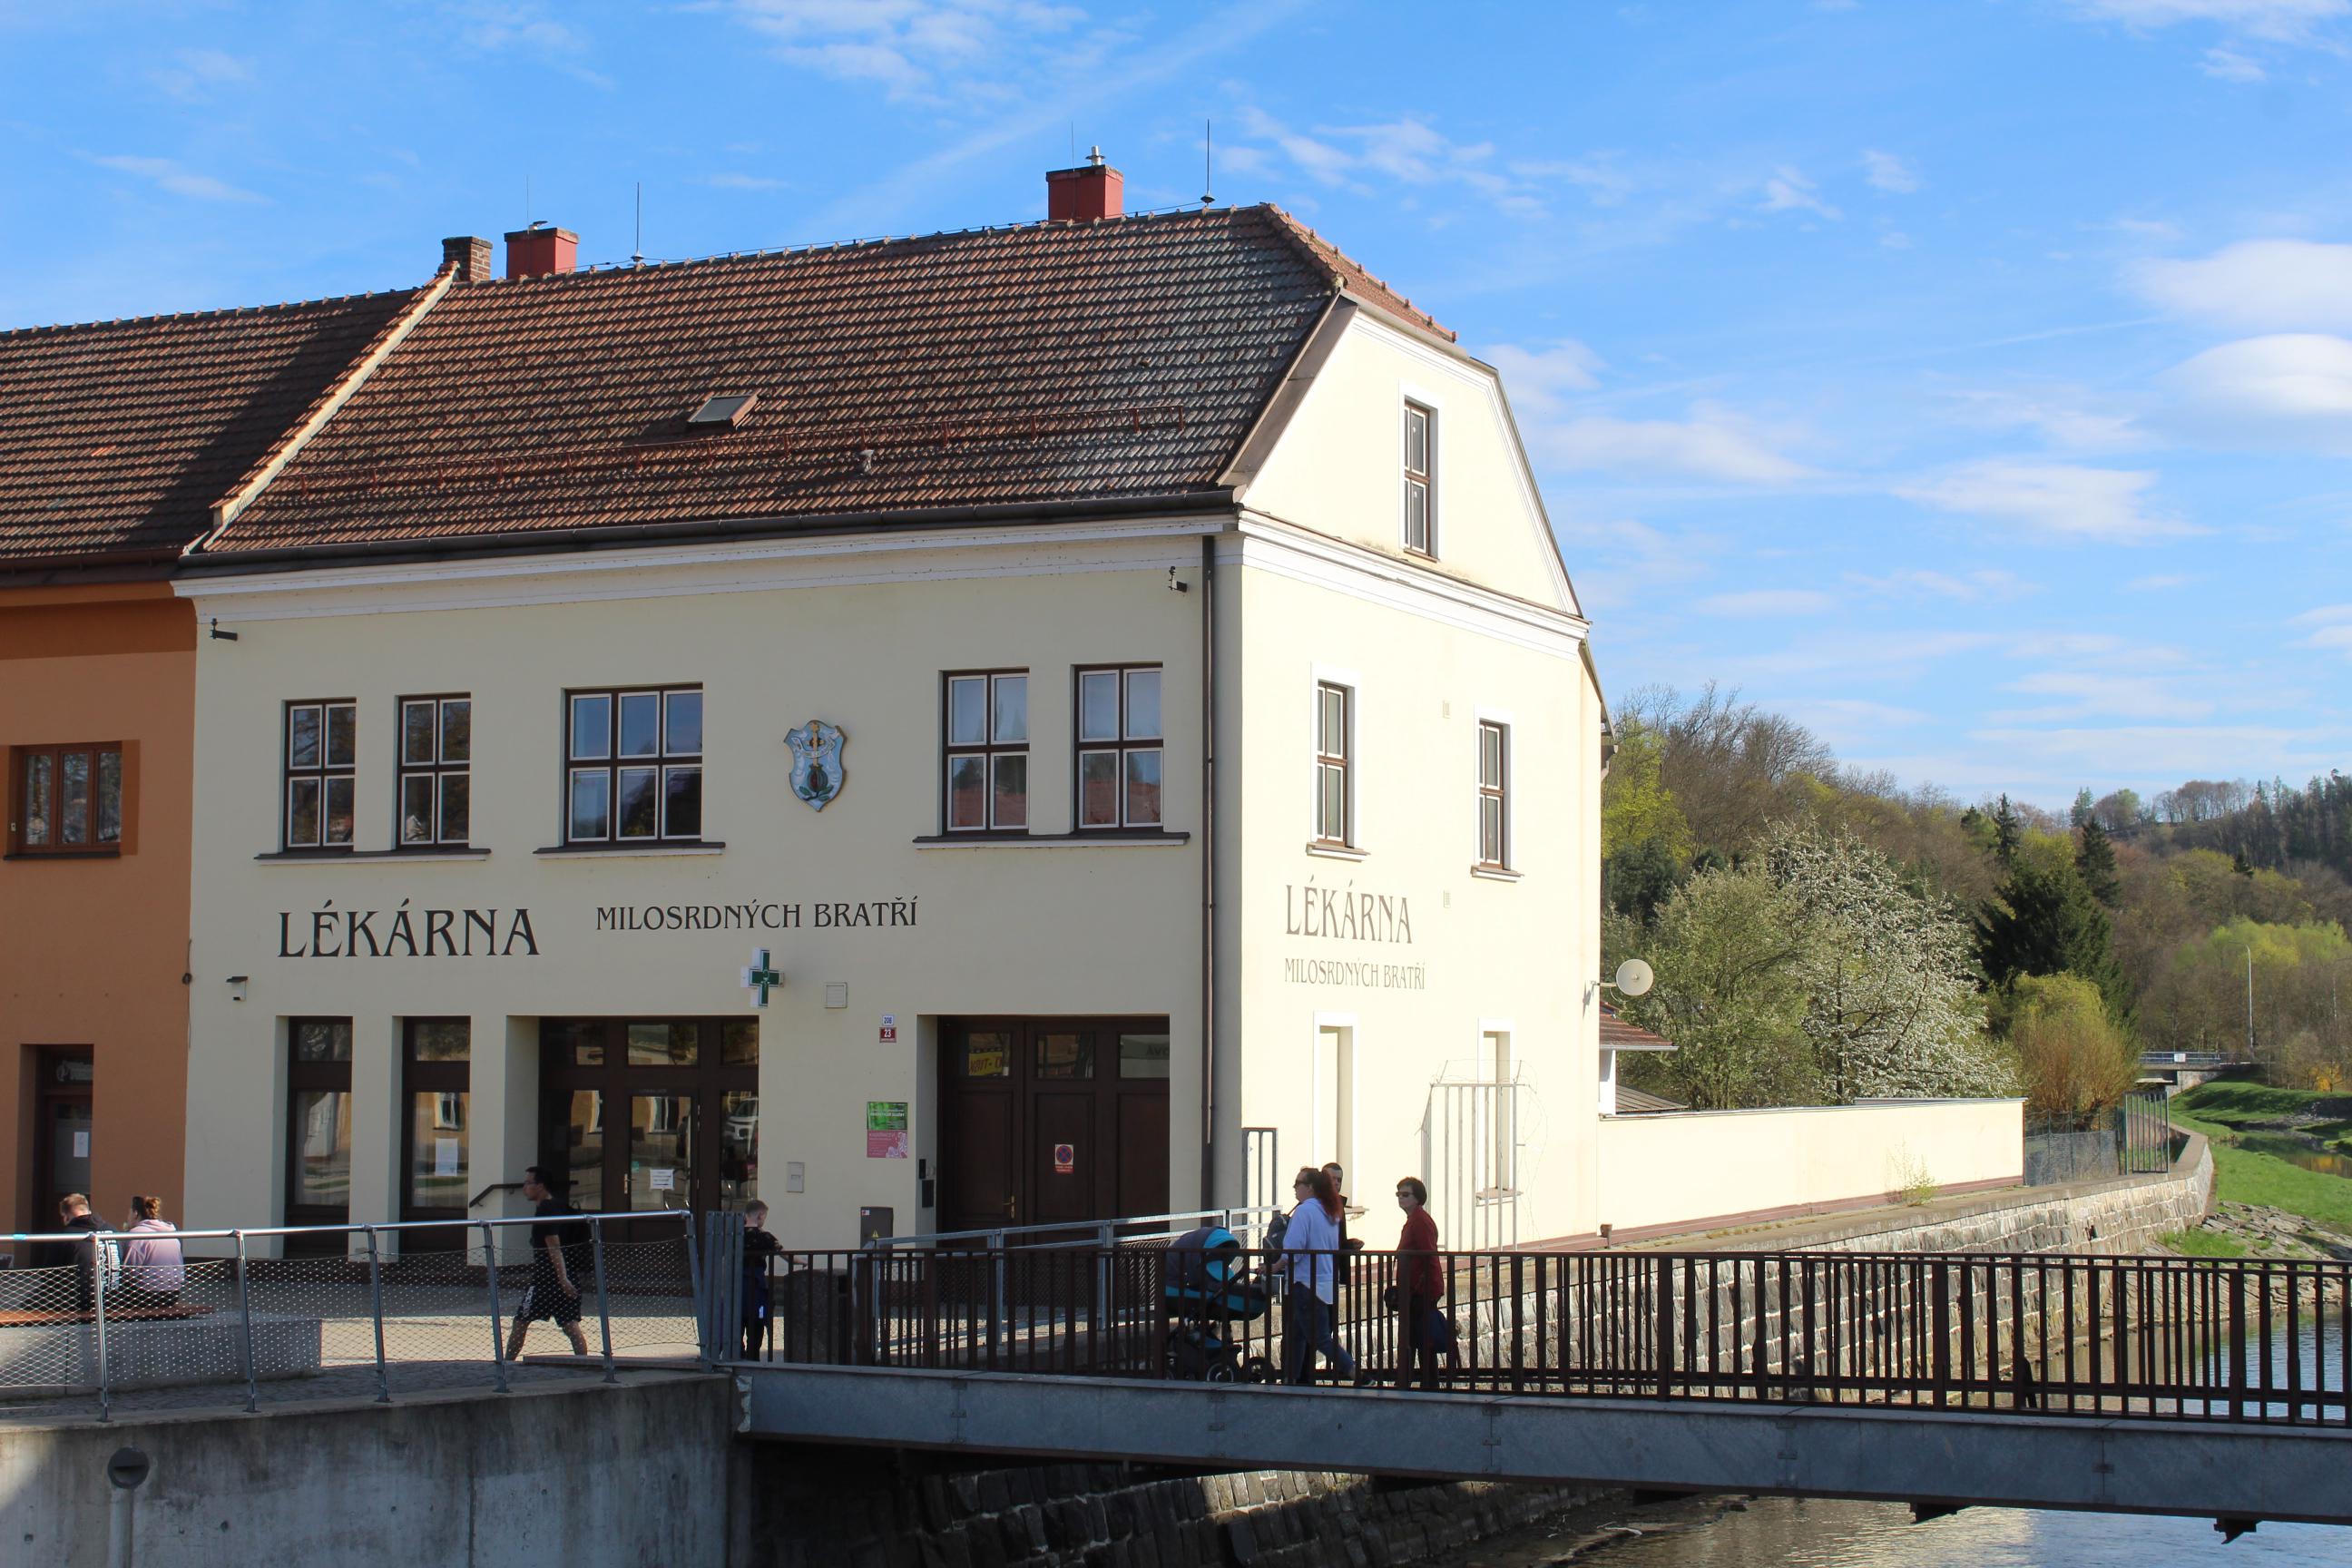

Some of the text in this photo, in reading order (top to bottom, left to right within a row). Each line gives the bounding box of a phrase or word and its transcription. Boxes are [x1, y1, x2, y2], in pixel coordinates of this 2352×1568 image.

[278, 898, 541, 957] LÉKÁRNA
[596, 895, 918, 931] MILOSRDNÝCH BRATŘÍ
[1285, 874, 1413, 945] LÉKÁRNA
[1284, 957, 1426, 990] MILOSRDNÝCH BRATŘÍ
[884, 1029, 892, 1038] 23
